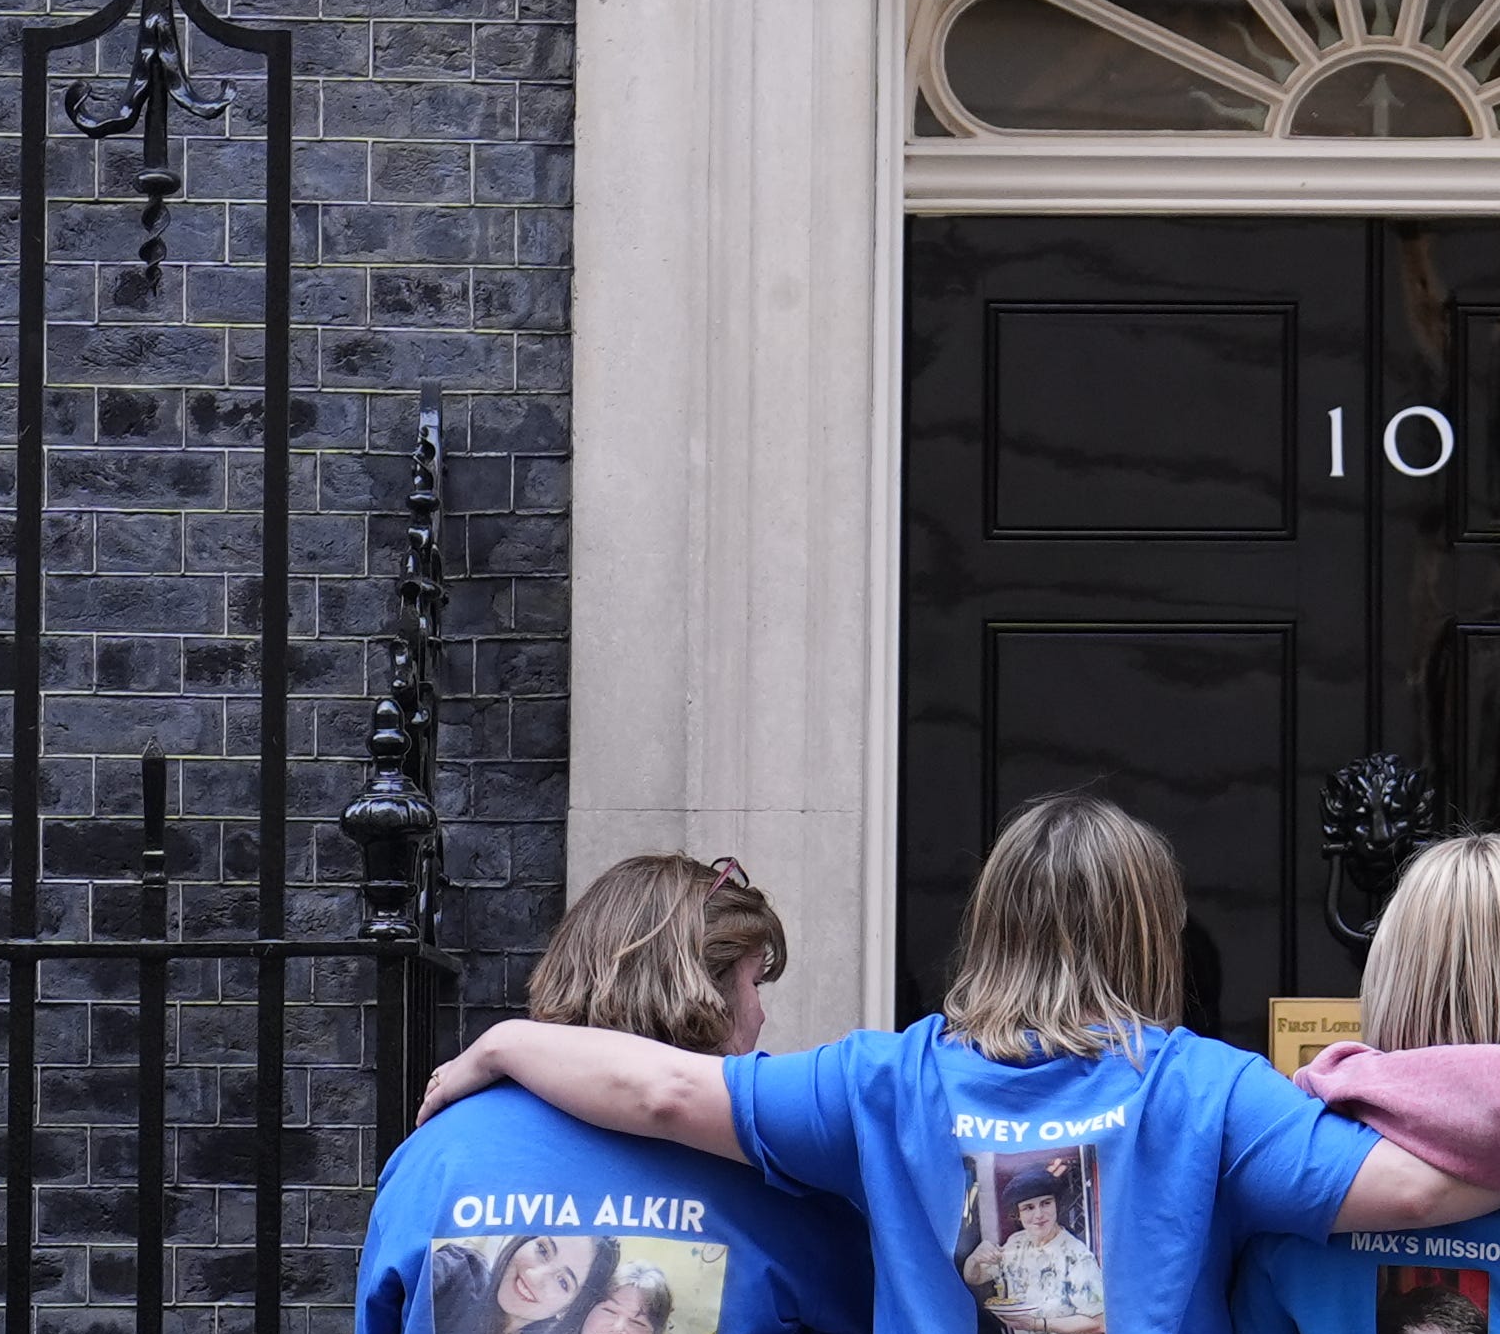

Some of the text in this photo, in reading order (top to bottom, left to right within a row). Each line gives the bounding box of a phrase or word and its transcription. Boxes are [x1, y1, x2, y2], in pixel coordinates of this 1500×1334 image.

[1328, 406, 1454, 477] 10
[952, 1105, 1125, 1142] RVEY OWEN
[452, 1194, 705, 1232] OLIVIA ALKIR
[1351, 1232, 1419, 1255] MAX'S
